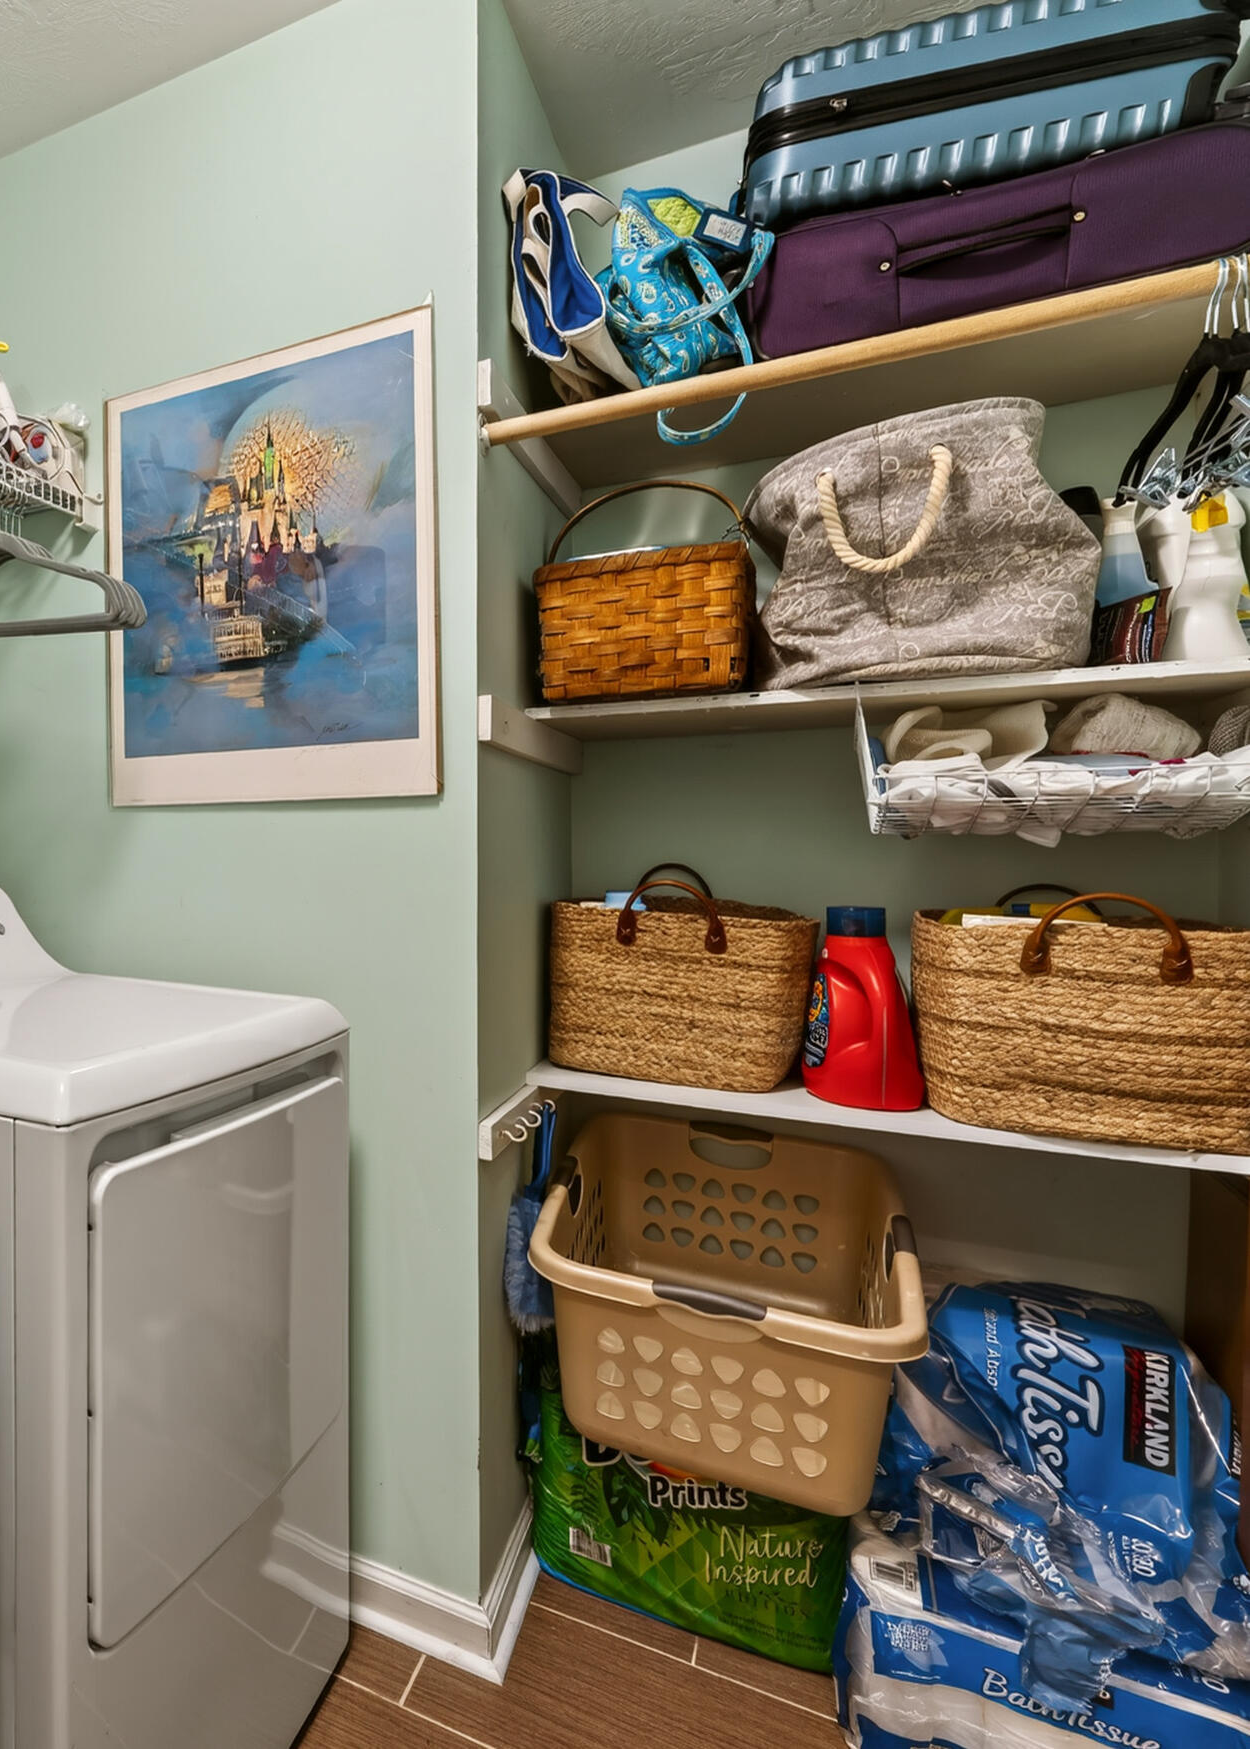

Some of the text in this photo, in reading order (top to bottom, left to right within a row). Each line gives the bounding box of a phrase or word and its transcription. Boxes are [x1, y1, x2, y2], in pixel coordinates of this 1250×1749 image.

[1144, 1351, 1170, 1468] KIRKLAND
[649, 1474, 747, 1508] Prints
[718, 1525, 824, 1562] Nature
[704, 1550, 818, 1592] Inspired
